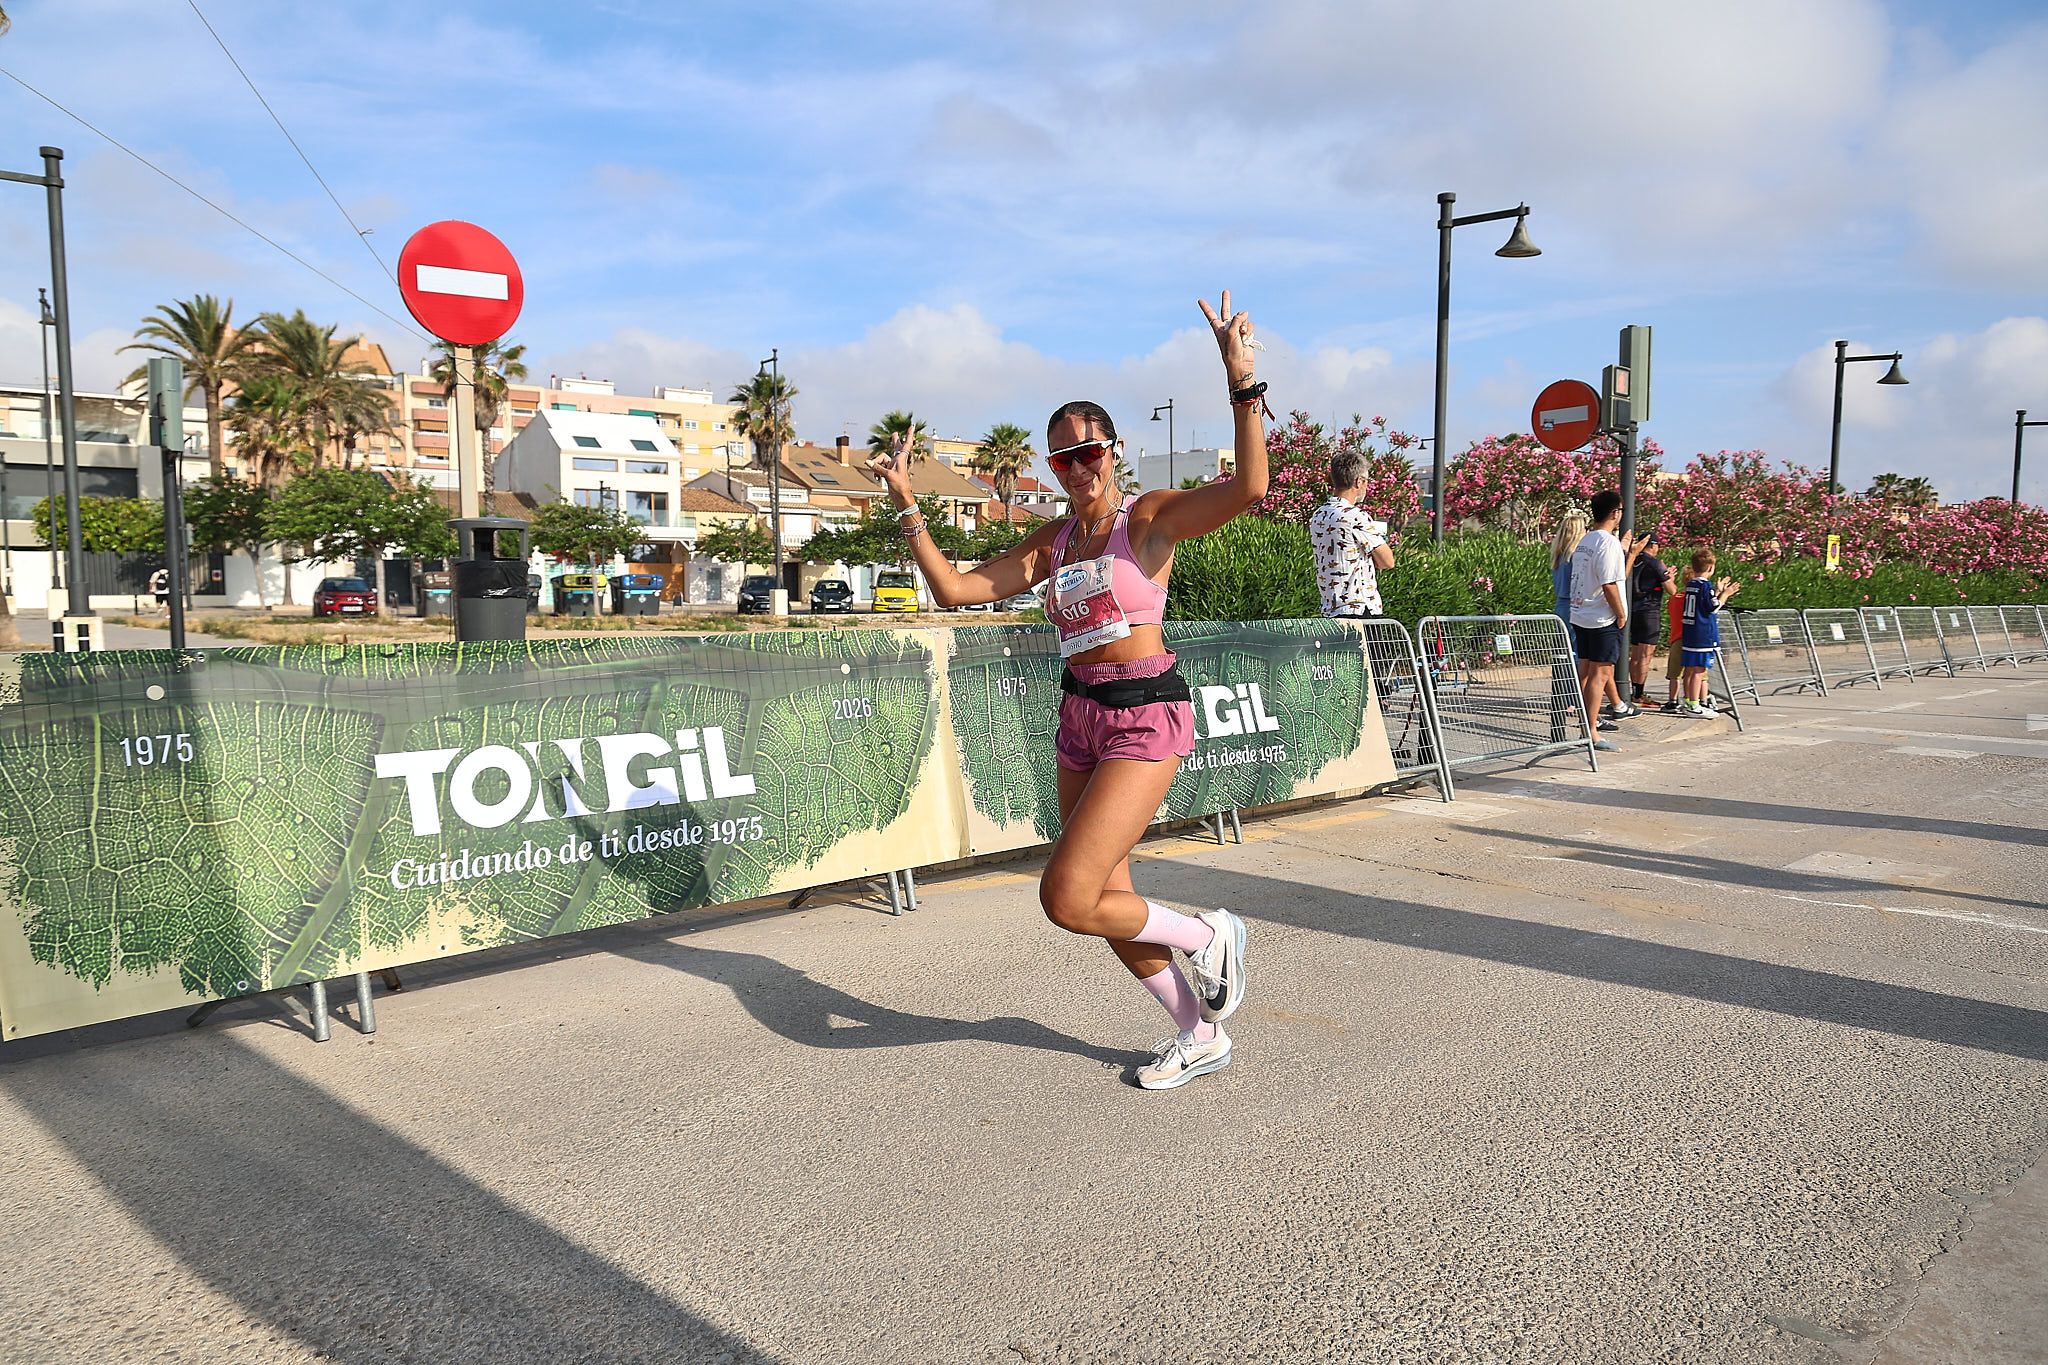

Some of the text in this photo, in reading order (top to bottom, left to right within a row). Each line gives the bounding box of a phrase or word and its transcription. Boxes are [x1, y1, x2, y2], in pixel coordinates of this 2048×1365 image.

[1683, 594, 1697, 617] 10
[1312, 664, 1334, 680] 2026
[996, 676, 1027, 697] 1975
[832, 697, 872, 720] 2026
[119, 733, 194, 767] 1975
[1188, 750, 1205, 772] de
[1206, 746, 1218, 769] ti
[1220, 744, 1258, 767] desde
[1259, 744, 1287, 763] 1975
[390, 814, 764, 890] Cuidando de ti desde 1975
